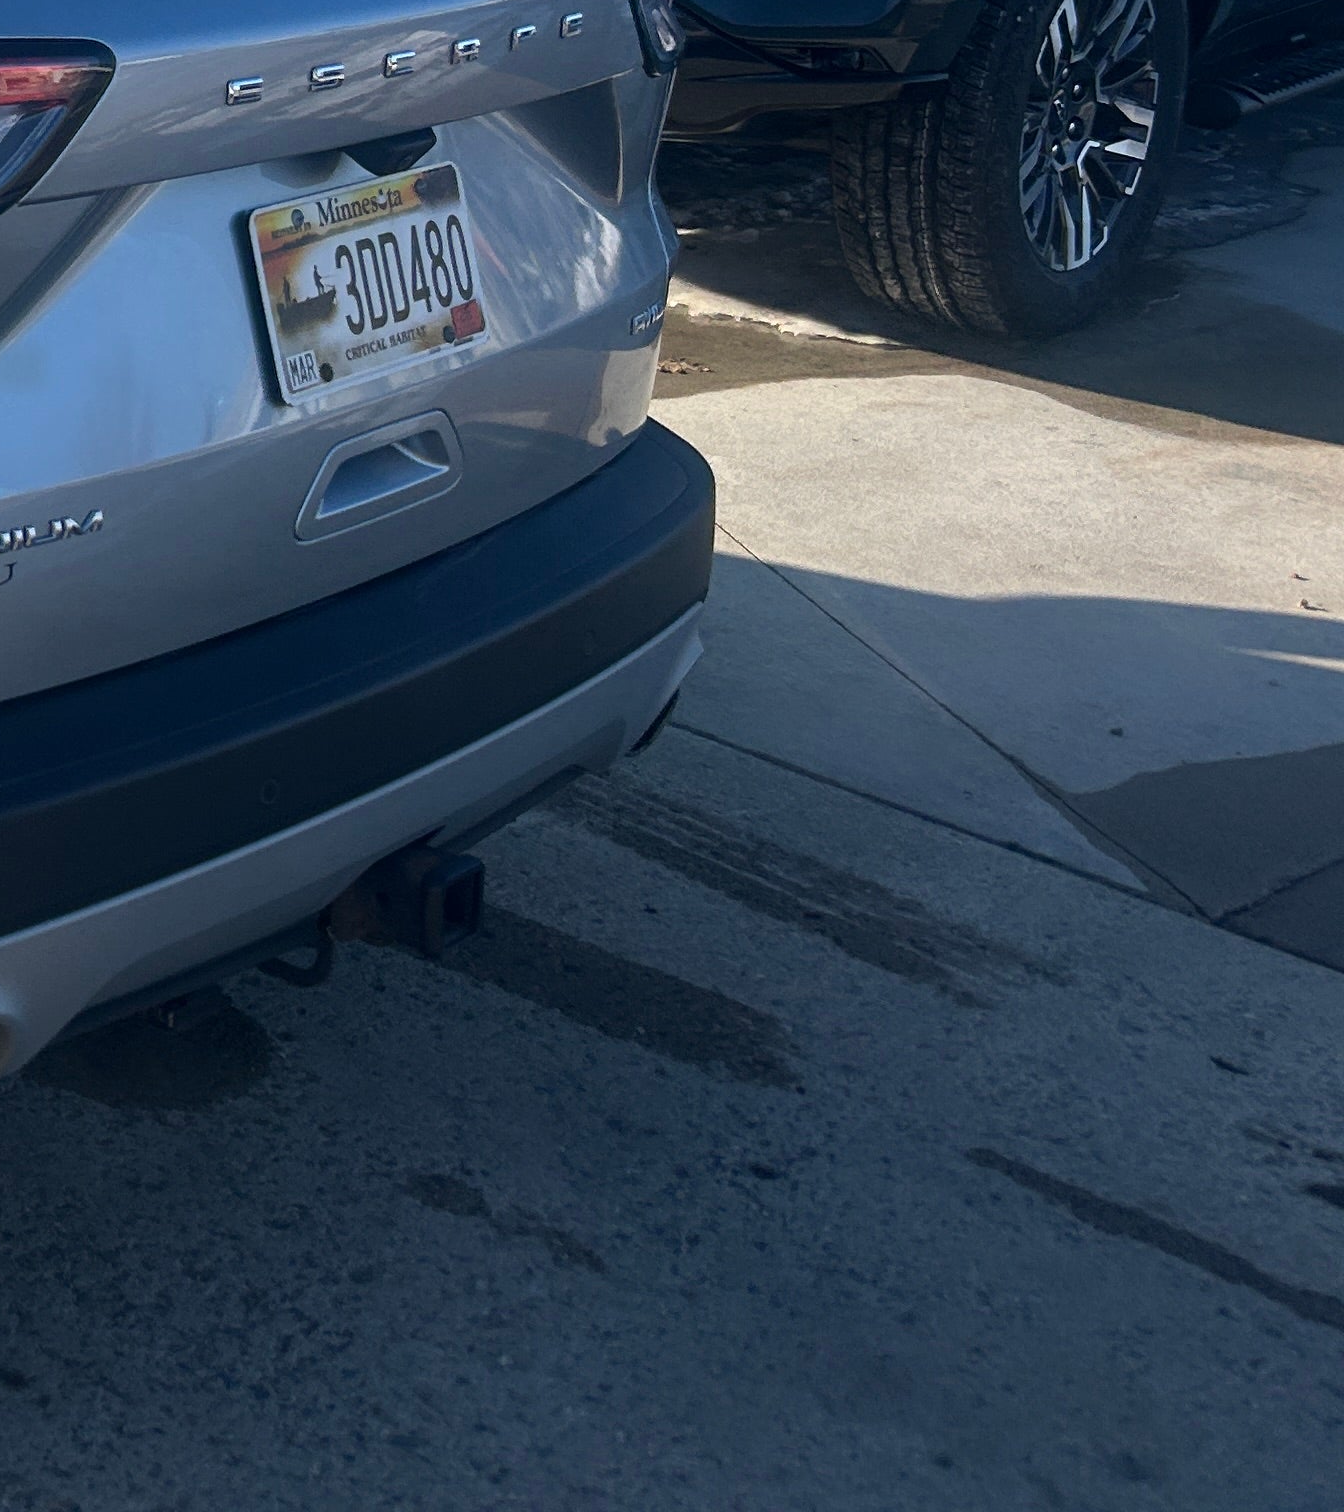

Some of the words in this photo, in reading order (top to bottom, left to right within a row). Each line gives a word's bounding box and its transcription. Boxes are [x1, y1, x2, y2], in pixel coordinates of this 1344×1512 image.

[225, 12, 583, 106] ESCAPE
[335, 214, 474, 335] 3DD480
[288, 355, 317, 387] MAR
[345, 337, 387, 361] CRITICAL
